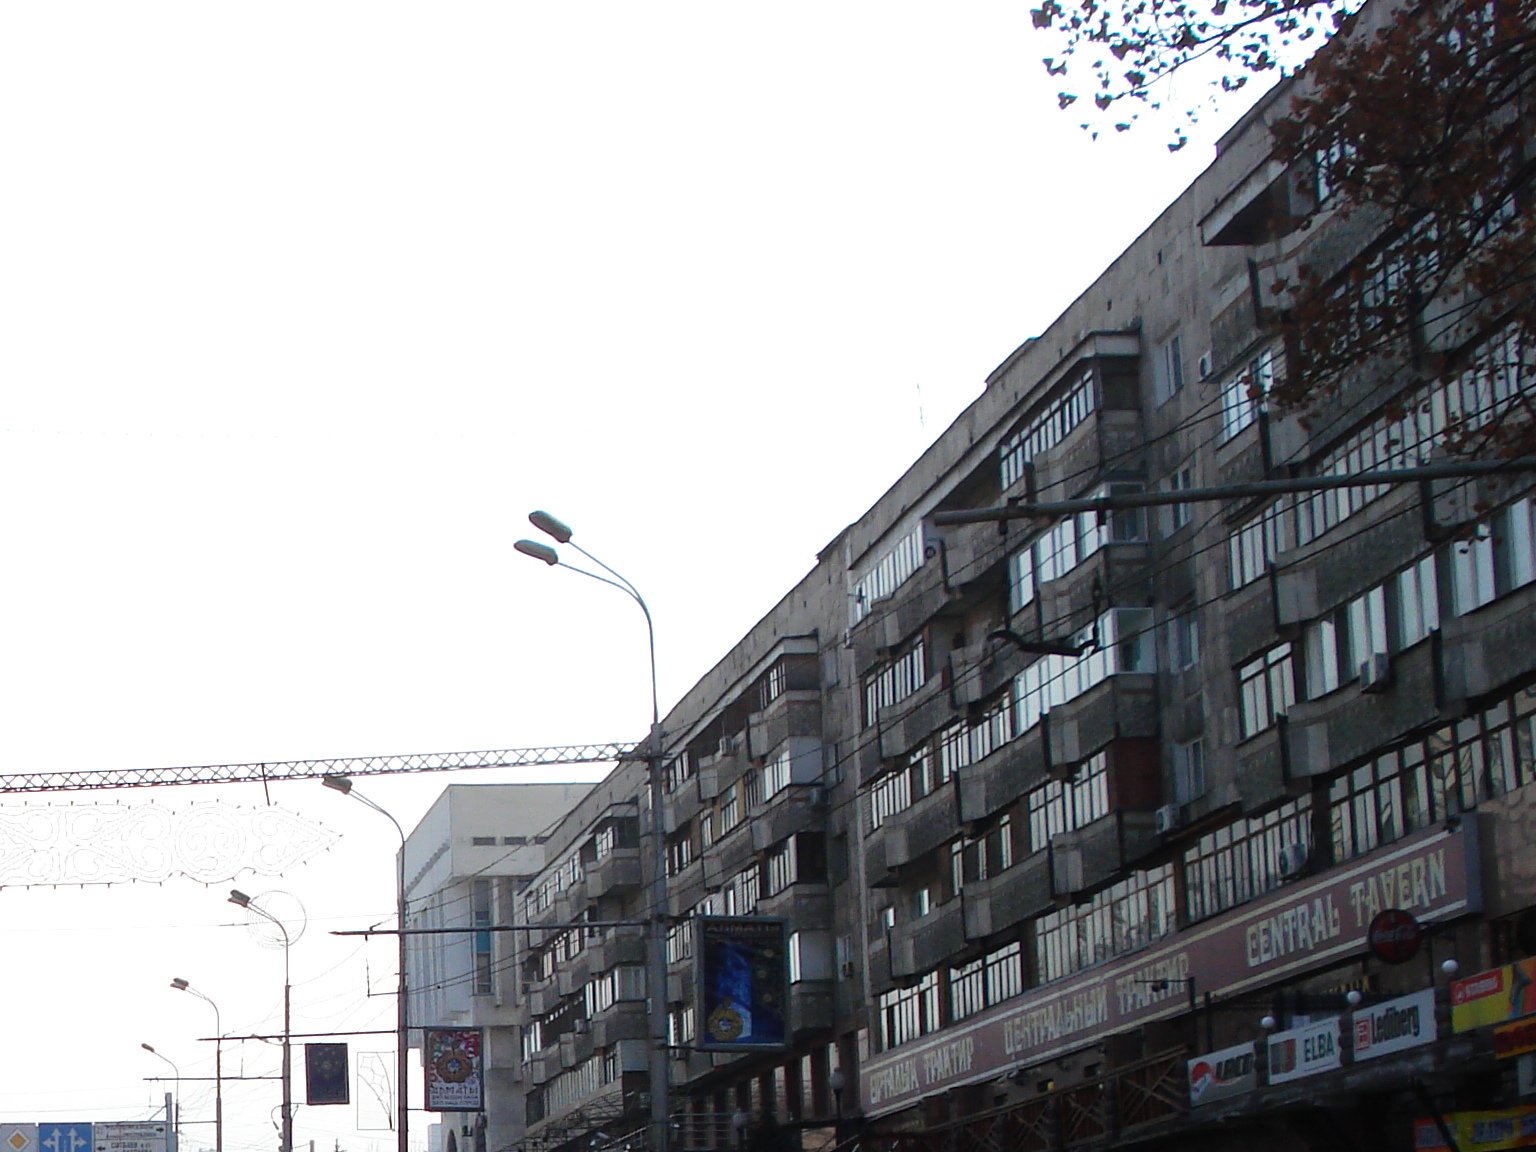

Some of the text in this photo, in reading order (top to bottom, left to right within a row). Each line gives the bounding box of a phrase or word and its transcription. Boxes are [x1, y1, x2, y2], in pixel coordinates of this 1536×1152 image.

[1245, 848, 1446, 967] CENTRAL TAVERN
[1304, 1032, 1335, 1063] ELBA
